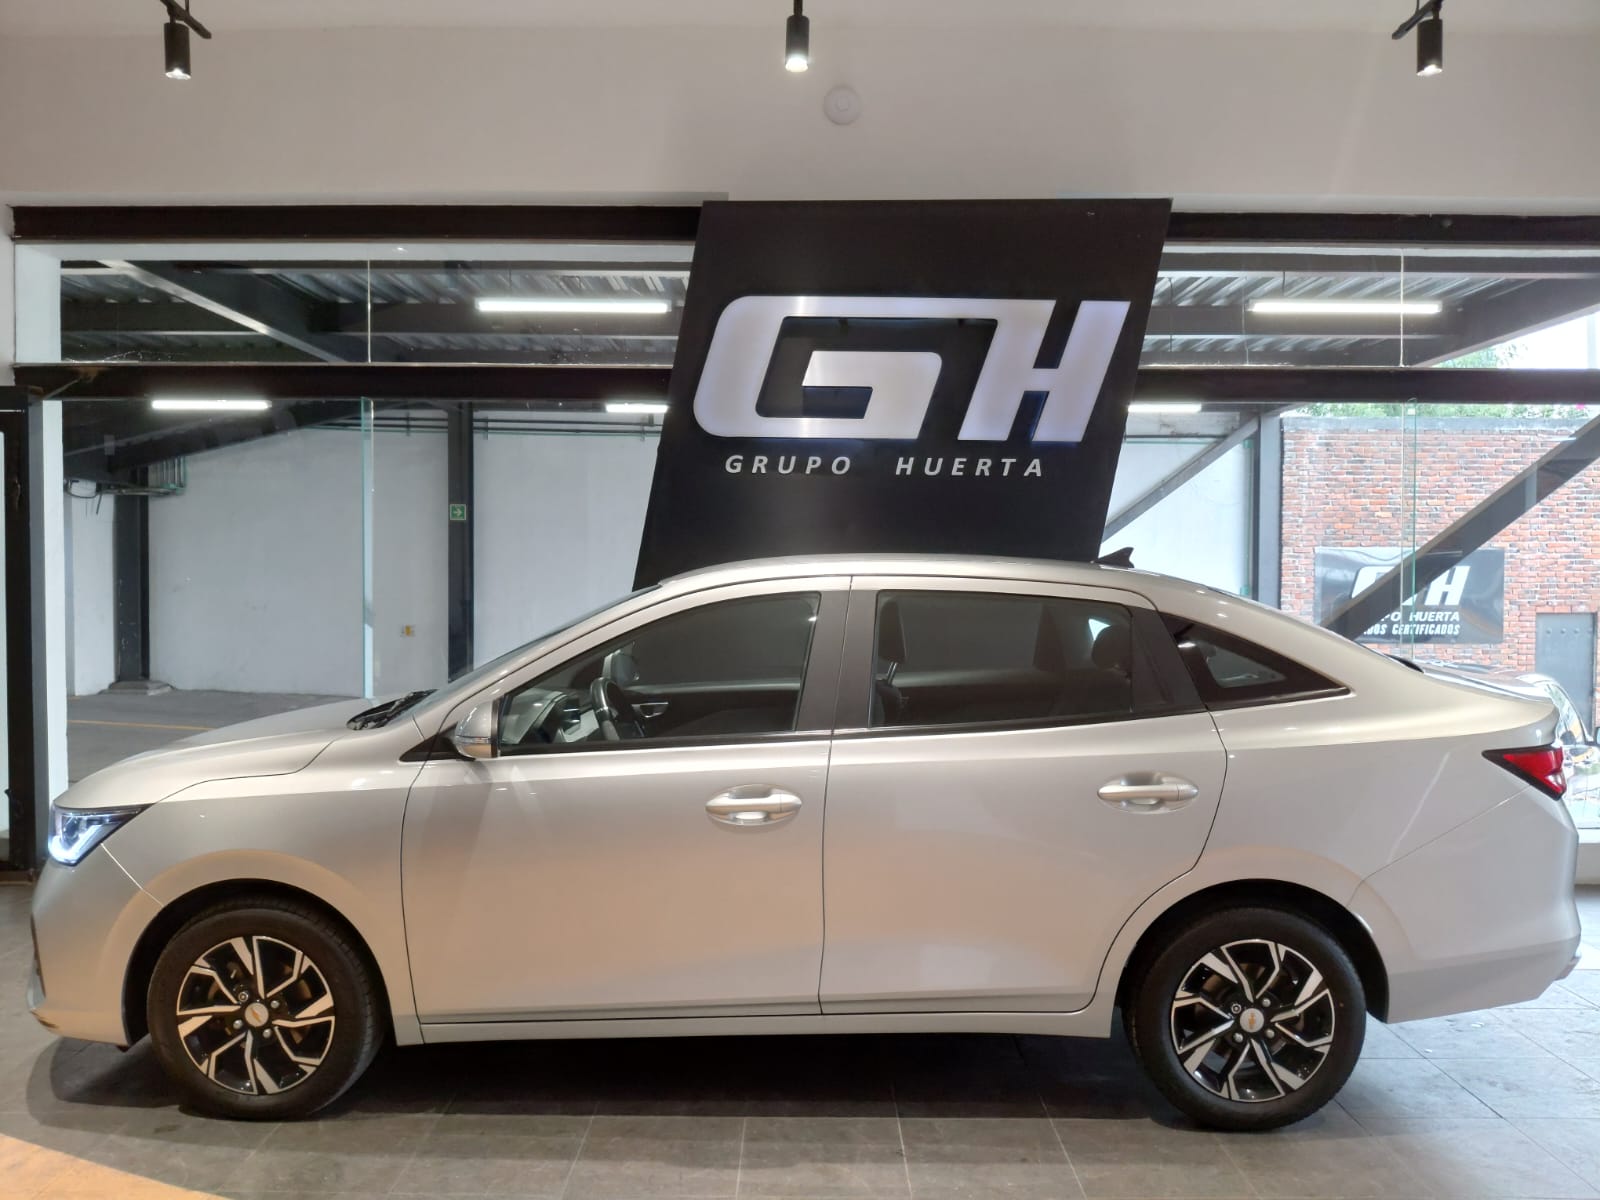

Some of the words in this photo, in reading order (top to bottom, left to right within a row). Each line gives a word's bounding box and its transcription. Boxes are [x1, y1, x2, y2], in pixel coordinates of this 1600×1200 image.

[693, 295, 1131, 443] GH
[725, 454, 851, 476] GRUPO
[896, 456, 1044, 477] HUERTA
[1408, 611, 1460, 622] HUERTA
[1391, 623, 1461, 635] CERTIFICADOS
